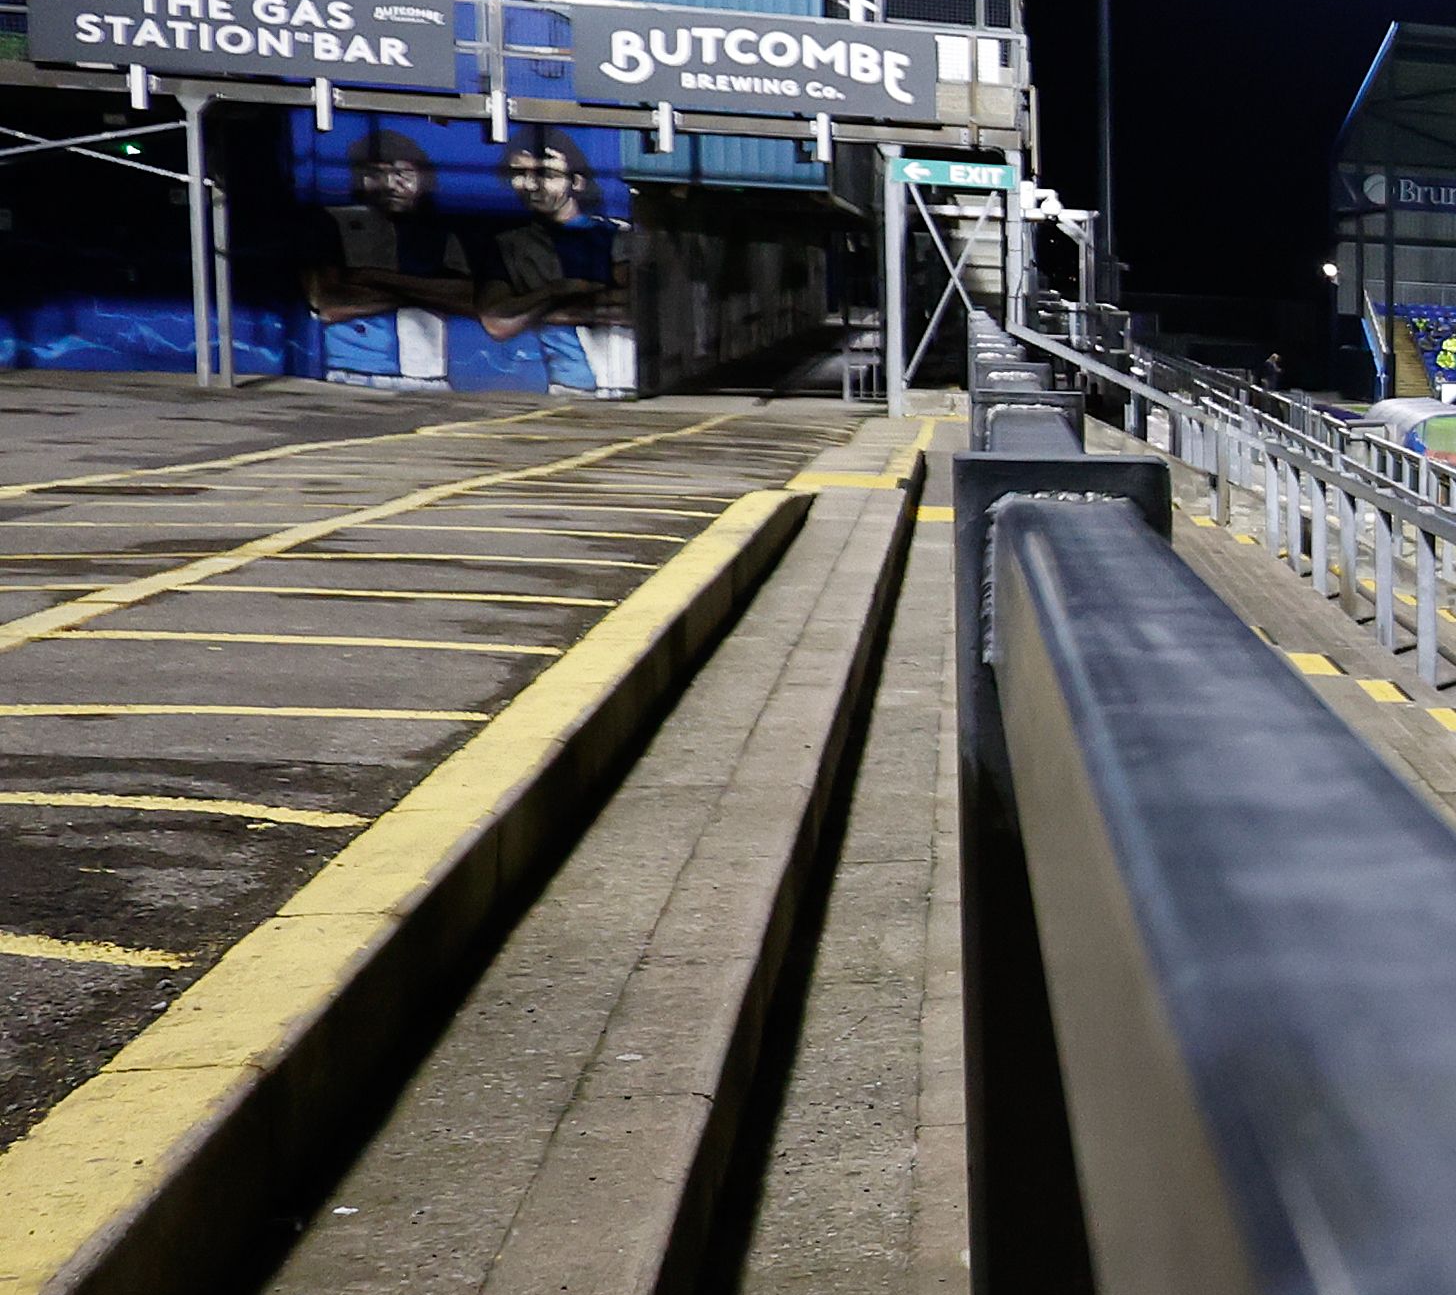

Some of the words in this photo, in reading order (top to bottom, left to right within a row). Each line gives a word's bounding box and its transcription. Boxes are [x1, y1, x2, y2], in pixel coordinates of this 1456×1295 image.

[75, 12, 295, 59] STATION
[312, 32, 414, 69] BAR
[600, 26, 915, 105] BUTCOMBE
[680, 72, 800, 97] BREWING
[948, 163, 1006, 185] EXIT
